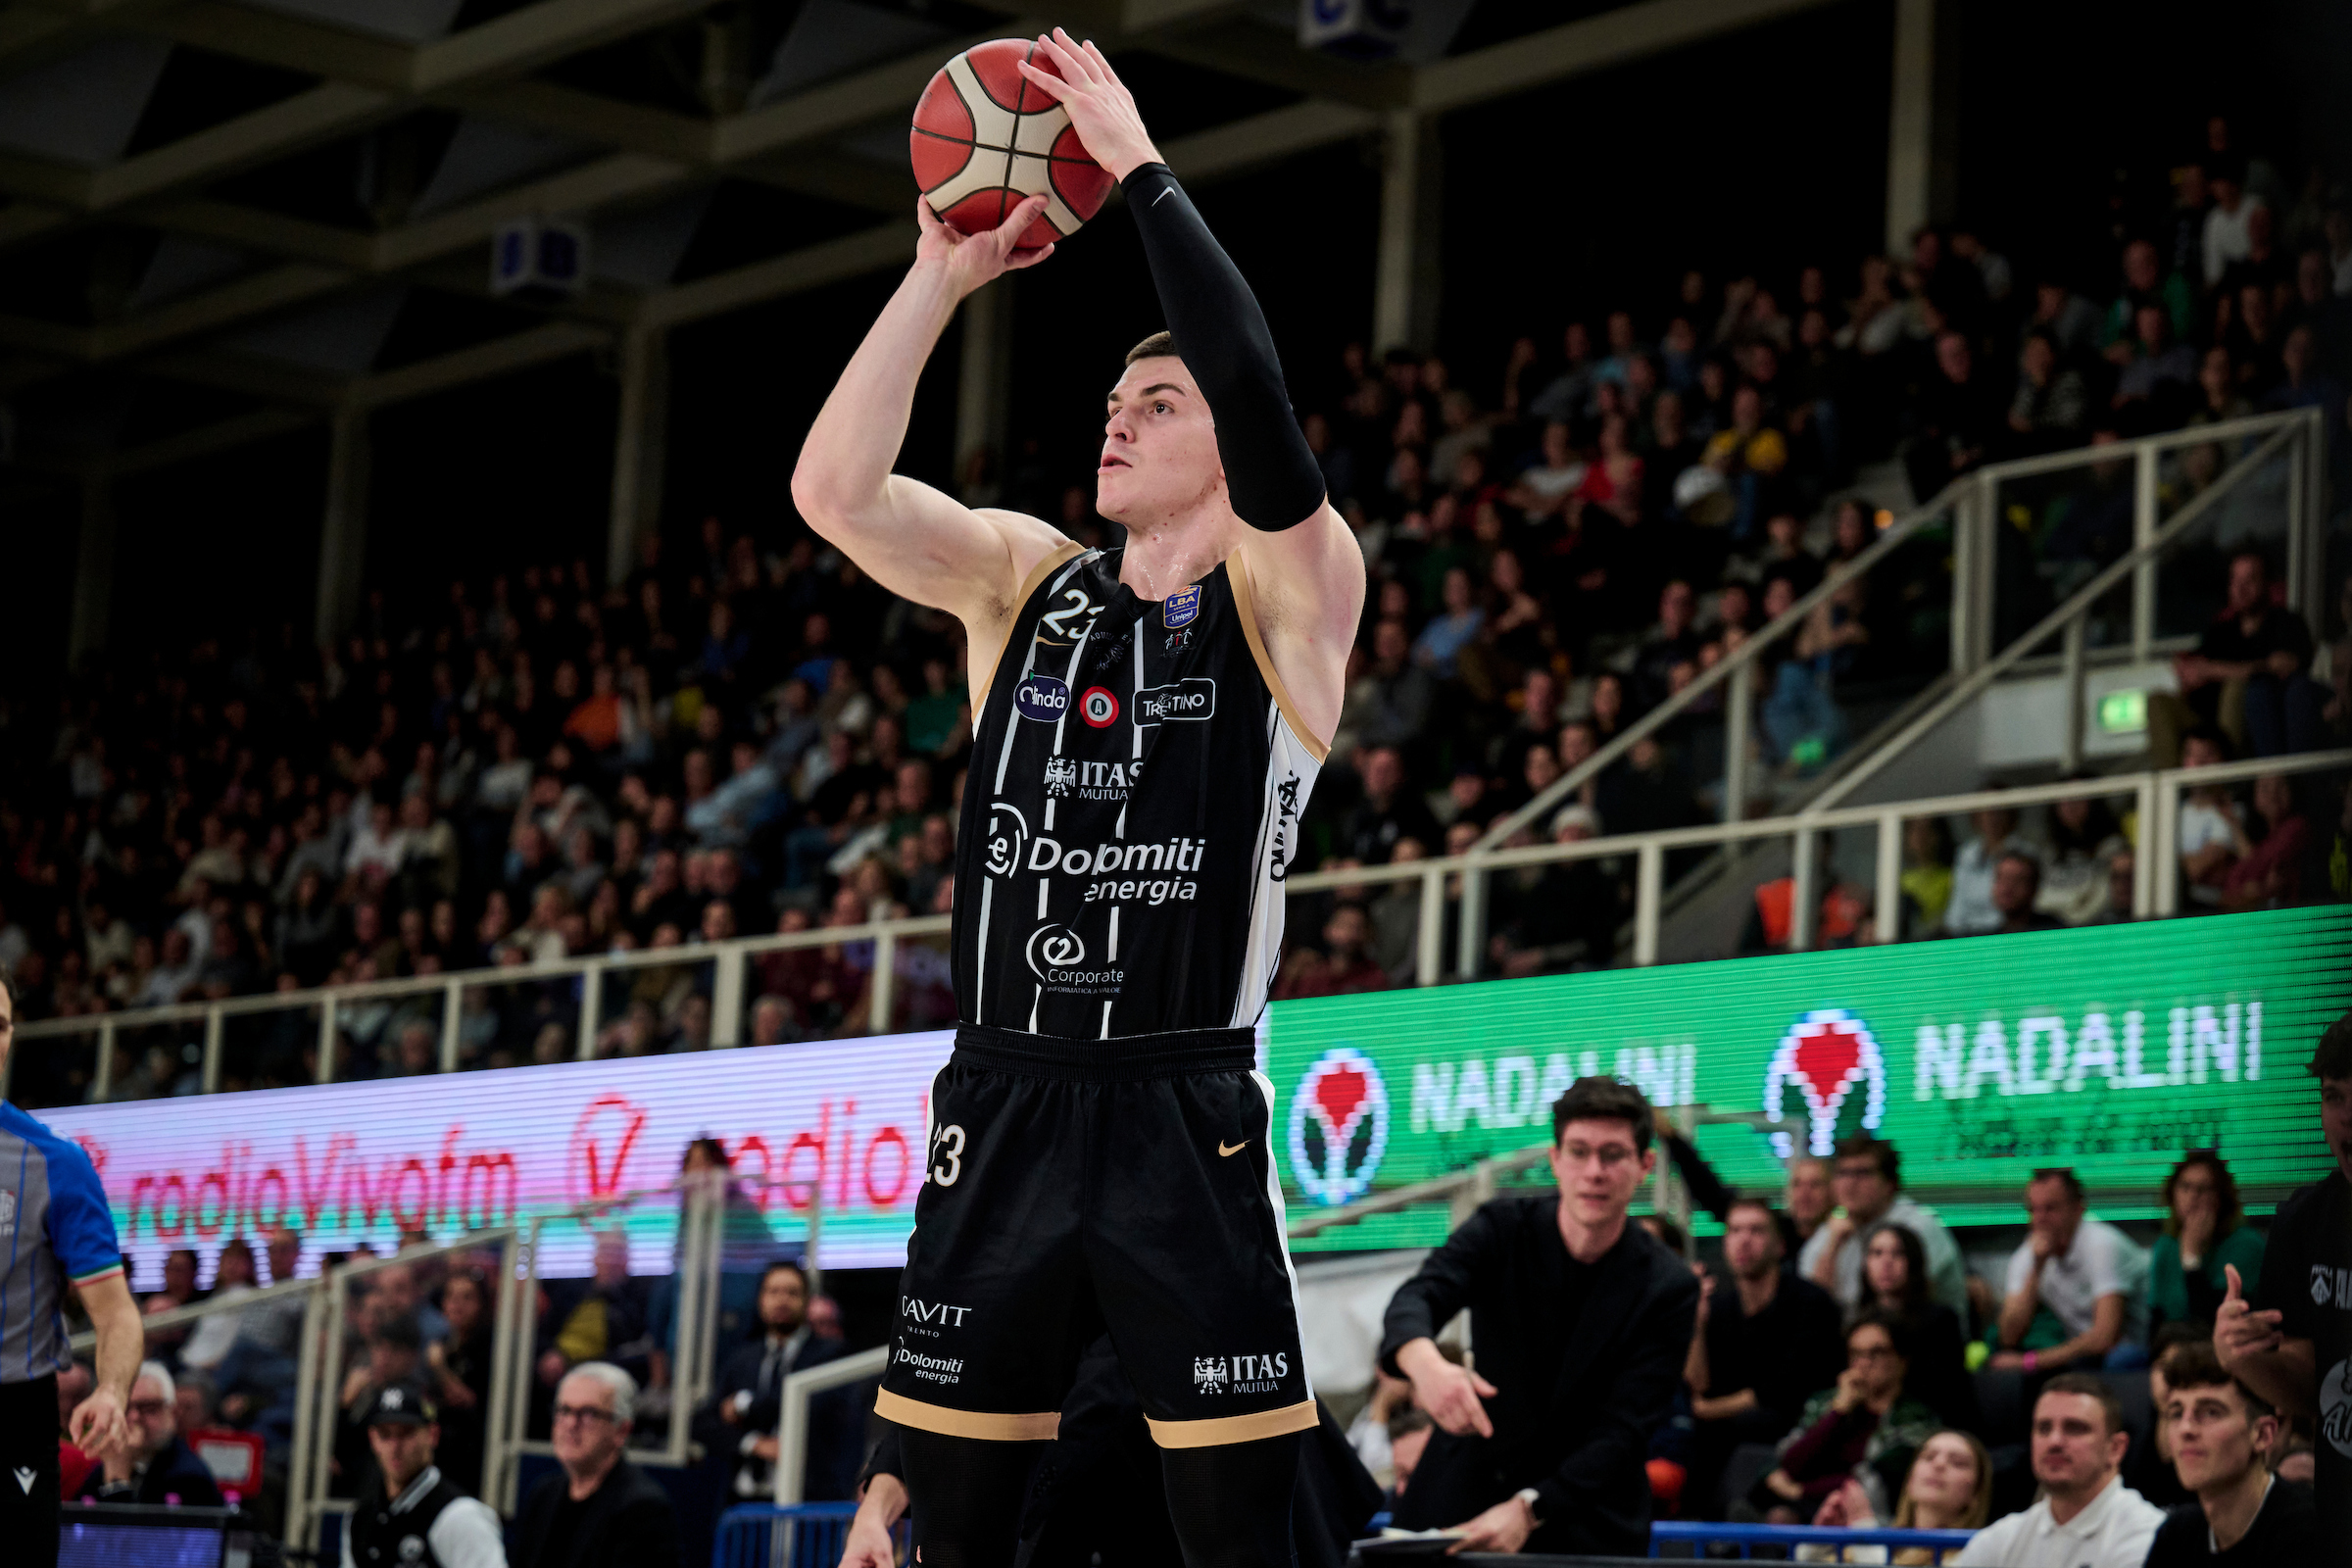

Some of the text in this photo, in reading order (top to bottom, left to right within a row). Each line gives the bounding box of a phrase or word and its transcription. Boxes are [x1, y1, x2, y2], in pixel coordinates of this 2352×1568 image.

[1169, 595, 1195, 608] LBA
[1172, 610, 1193, 621] Unipol
[1079, 788, 1128, 801] MUTUA
[1028, 837, 1205, 876] Dolomiti
[1084, 876, 1198, 906] energia
[1048, 968, 1124, 986] Corporate
[1047, 986, 1091, 995] INFORMATICA
[1913, 998, 2262, 1102] NADALINI
[900, 1348, 963, 1373] Dolomiti
[1232, 1352, 1288, 1381] ITAS
[915, 1369, 959, 1385] energia
[1234, 1380, 1279, 1394] MUTUA
